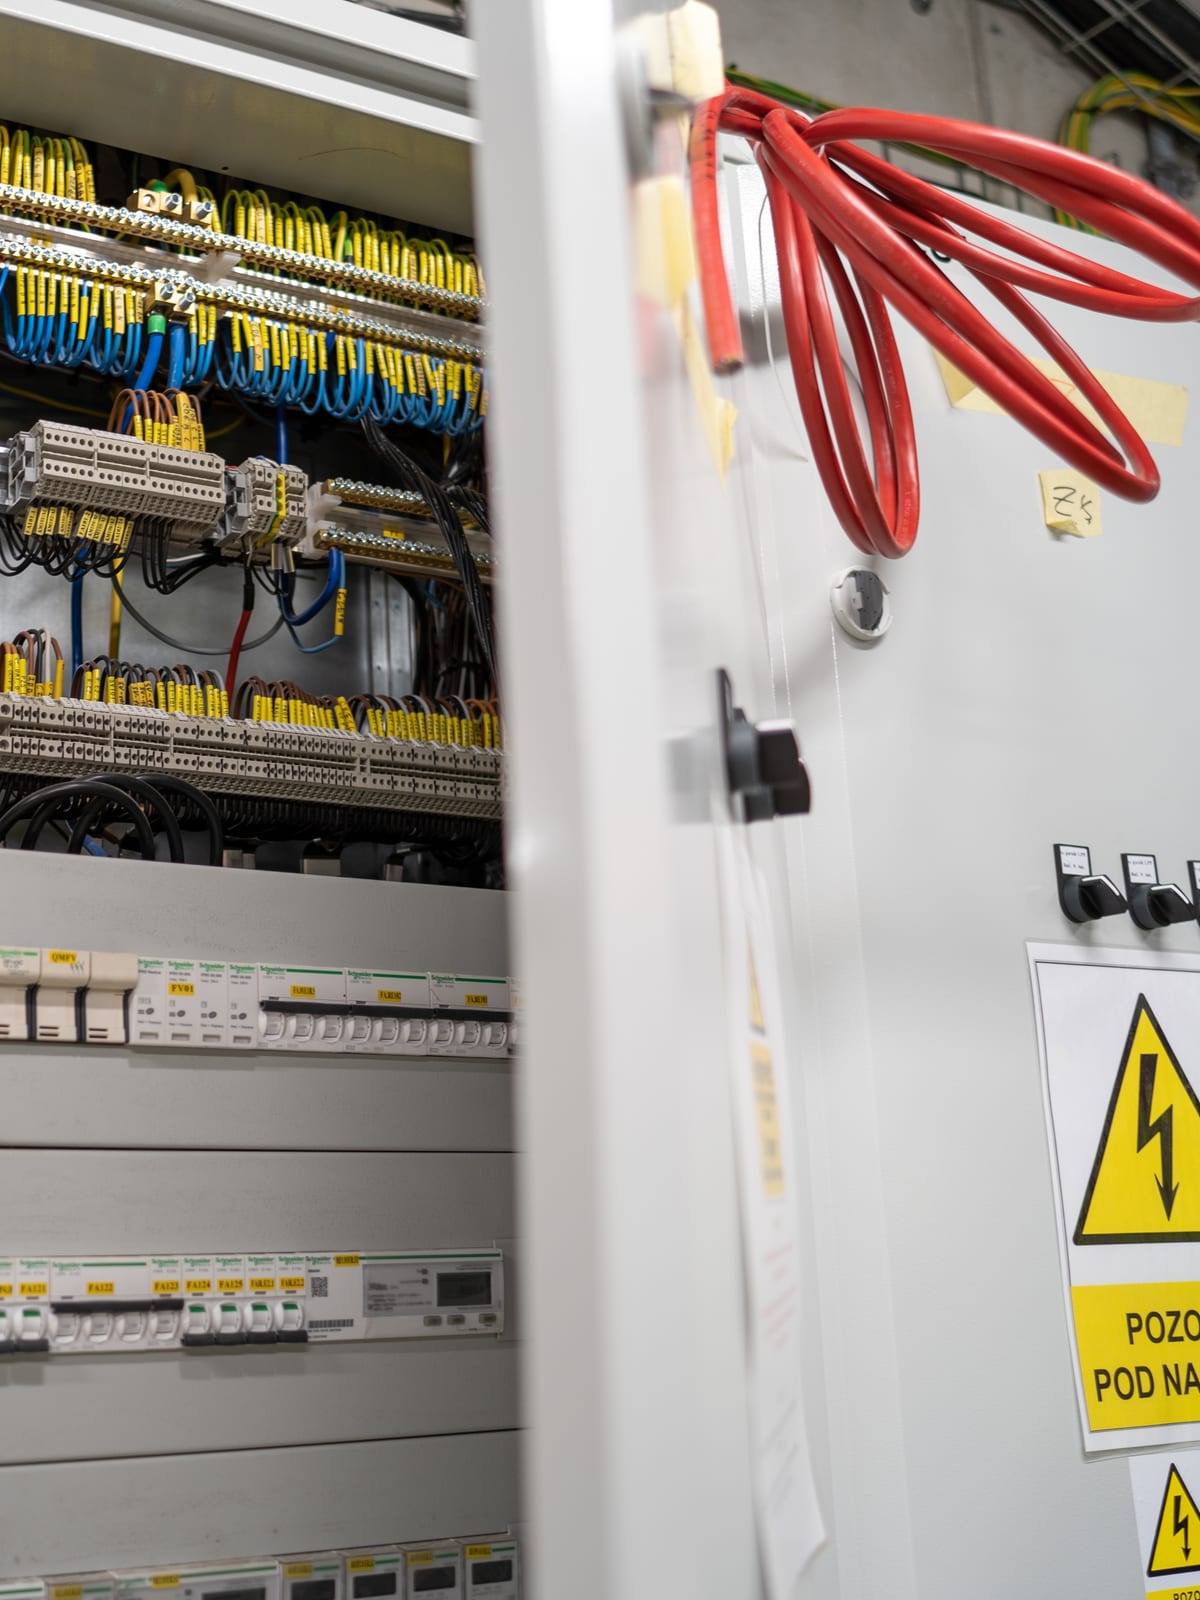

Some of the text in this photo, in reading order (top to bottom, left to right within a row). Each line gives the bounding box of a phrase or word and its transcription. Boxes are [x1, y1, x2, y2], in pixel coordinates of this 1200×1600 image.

[171, 983, 194, 993] FV01
[87, 1282, 114, 1292] FA122
[154, 1281, 179, 1291] FA123
[186, 1280, 211, 1290] FA124
[218, 1279, 243, 1289] FA125
[1125, 1309, 1200, 1345] POZO
[1093, 1362, 1200, 1402] POD NA
